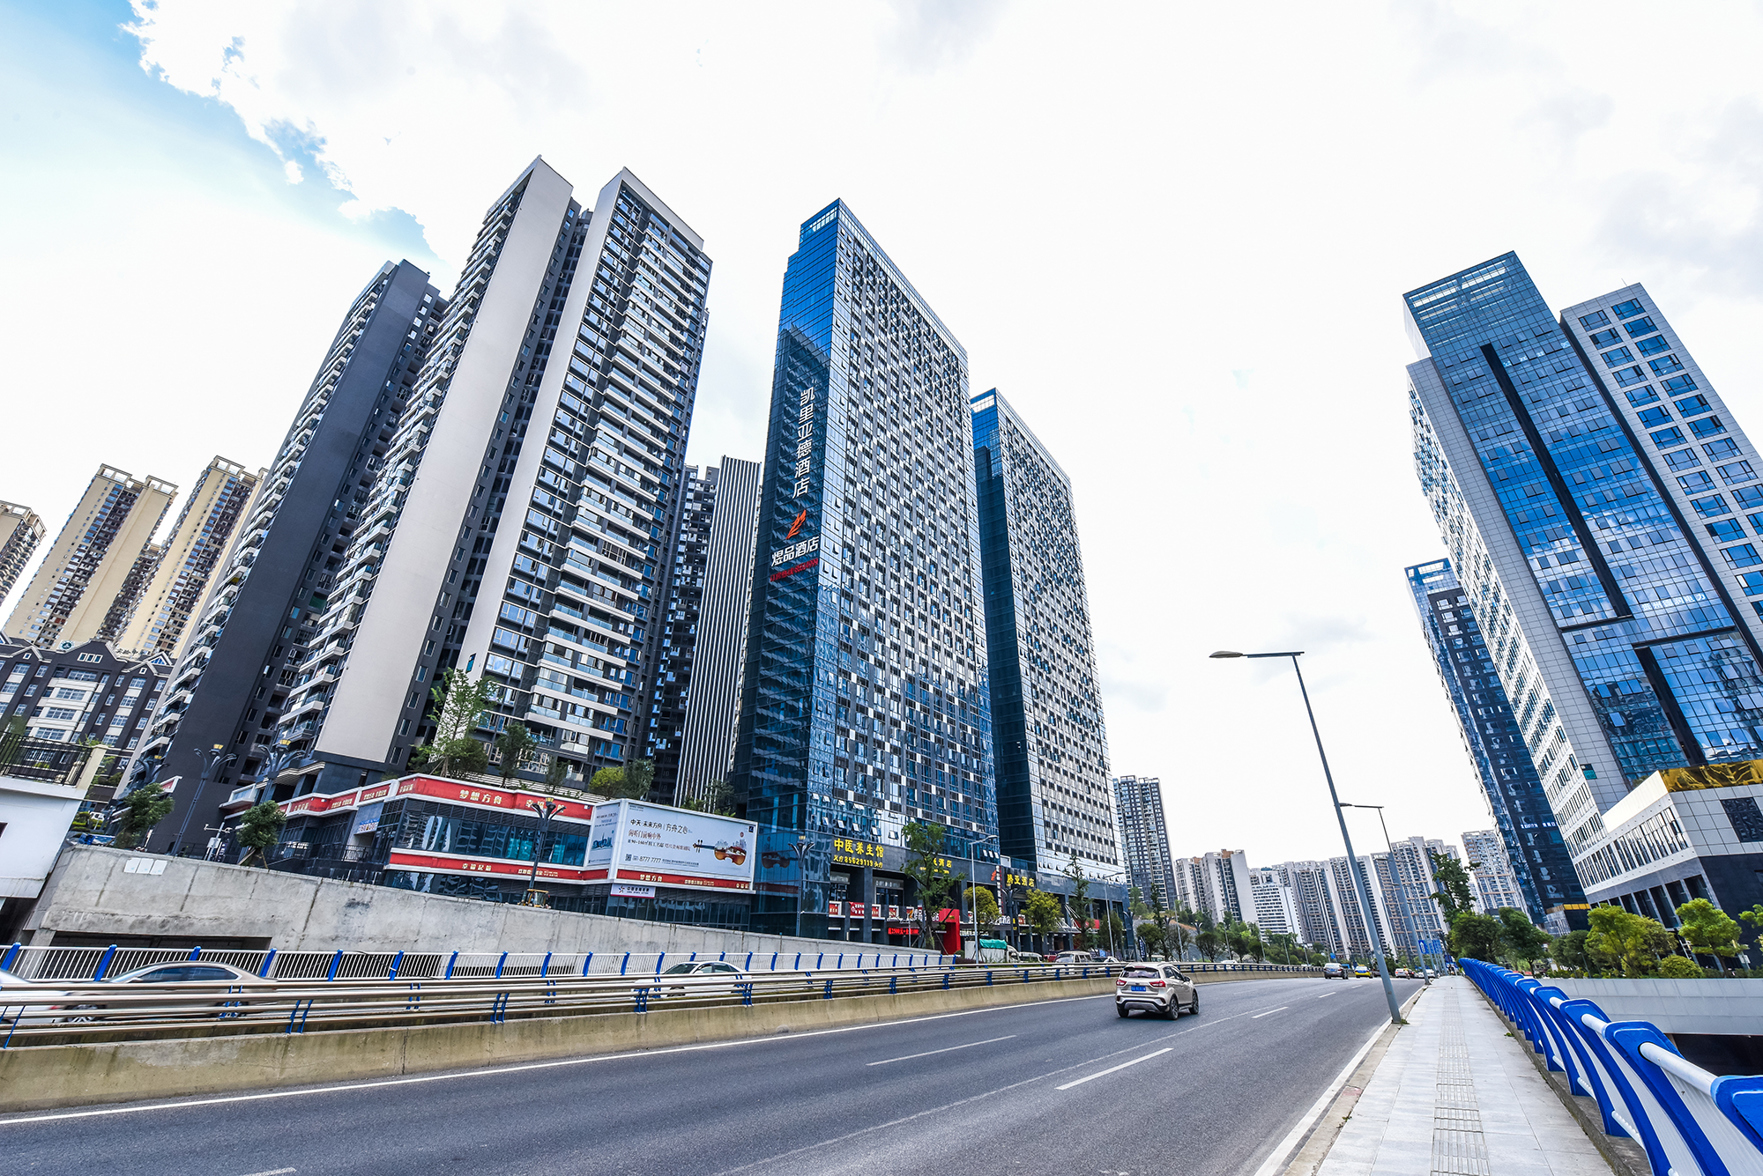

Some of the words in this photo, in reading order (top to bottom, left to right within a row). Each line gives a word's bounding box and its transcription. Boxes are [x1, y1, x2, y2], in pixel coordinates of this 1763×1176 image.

[792, 386, 816, 499] 凯里亚德酒店
[834, 838, 885, 858] 中医养生馆
